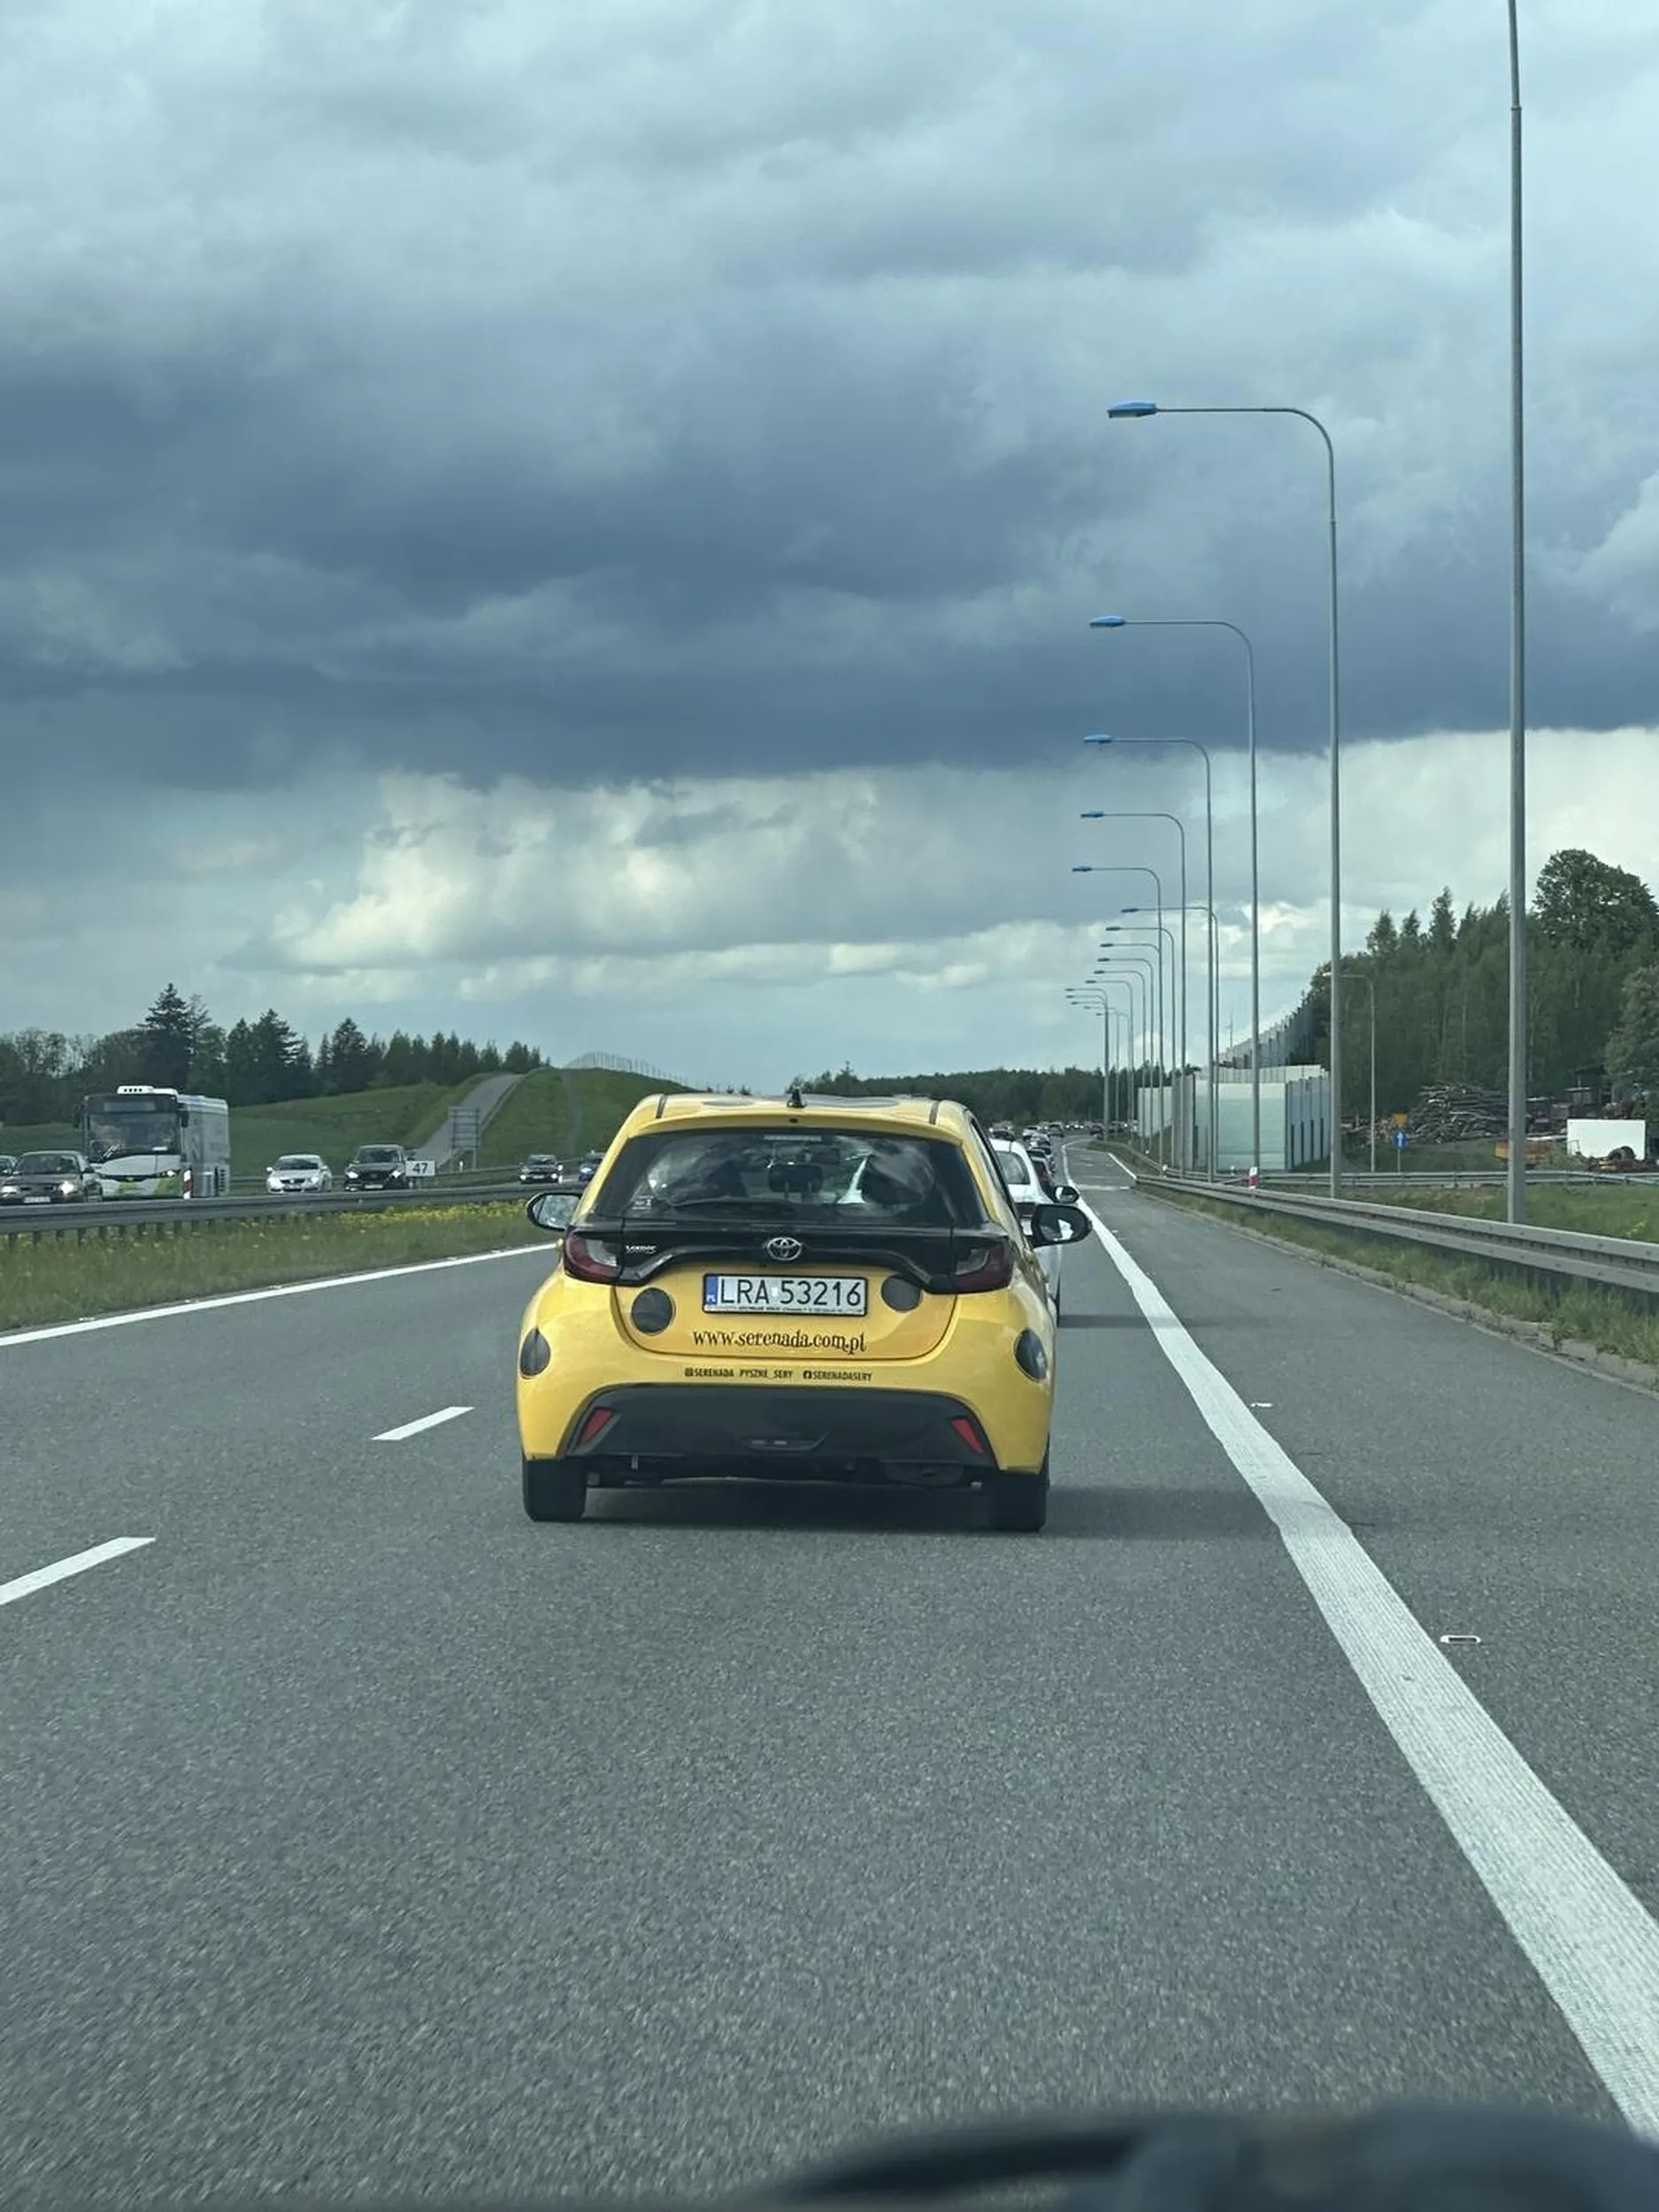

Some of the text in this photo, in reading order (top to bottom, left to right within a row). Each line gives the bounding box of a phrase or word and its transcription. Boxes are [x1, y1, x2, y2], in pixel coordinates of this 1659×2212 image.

[412, 1162, 429, 1174] 47
[720, 1278, 864, 1307] LRA 53216
[694, 1330, 866, 1355] www.serenada.com.pl
